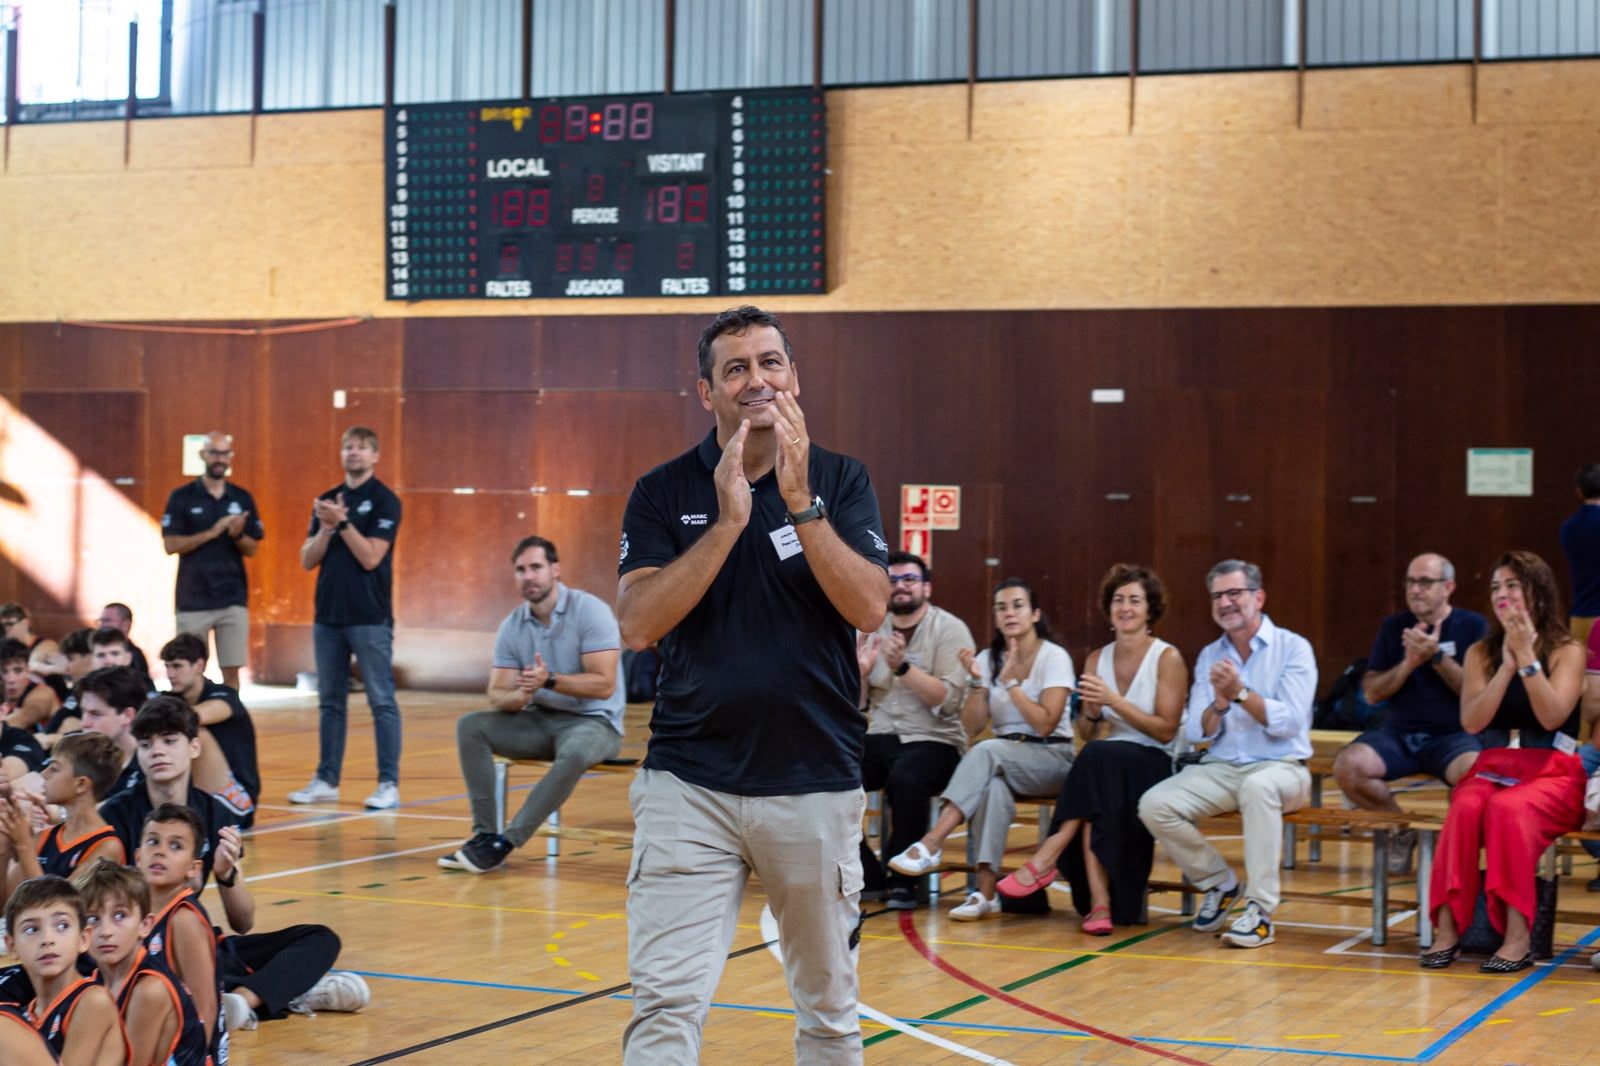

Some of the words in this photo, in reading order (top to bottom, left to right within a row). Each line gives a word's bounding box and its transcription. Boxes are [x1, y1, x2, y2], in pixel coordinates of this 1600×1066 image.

[731, 96, 743, 109] 4
[396, 109, 407, 122] 4
[732, 112, 744, 126] 5
[396, 125, 407, 139] 5
[732, 128, 744, 143] 6
[396, 141, 408, 155] 6
[732, 145, 744, 159] 7
[397, 156, 408, 170] 7
[487, 158, 551, 178] LOCAL
[647, 153, 706, 172] VISITANT
[732, 161, 745, 176] 8
[396, 172, 408, 186] 8
[732, 178, 745, 193] 9
[396, 188, 408, 202] 9
[727, 195, 745, 209] 10
[391, 204, 408, 218] 10
[727, 212, 744, 225] 11
[391, 220, 406, 233] 11
[391, 235, 408, 249] 12
[728, 228, 745, 242] 12
[392, 251, 408, 265] 13
[728, 244, 746, 258] 13
[392, 267, 408, 280] 14
[728, 261, 746, 275] 14
[392, 282, 408, 296] 15
[486, 280, 532, 297] FALTES
[565, 279, 624, 295] JUGADOR
[661, 277, 710, 295] FALTES
[728, 277, 746, 291] 15
